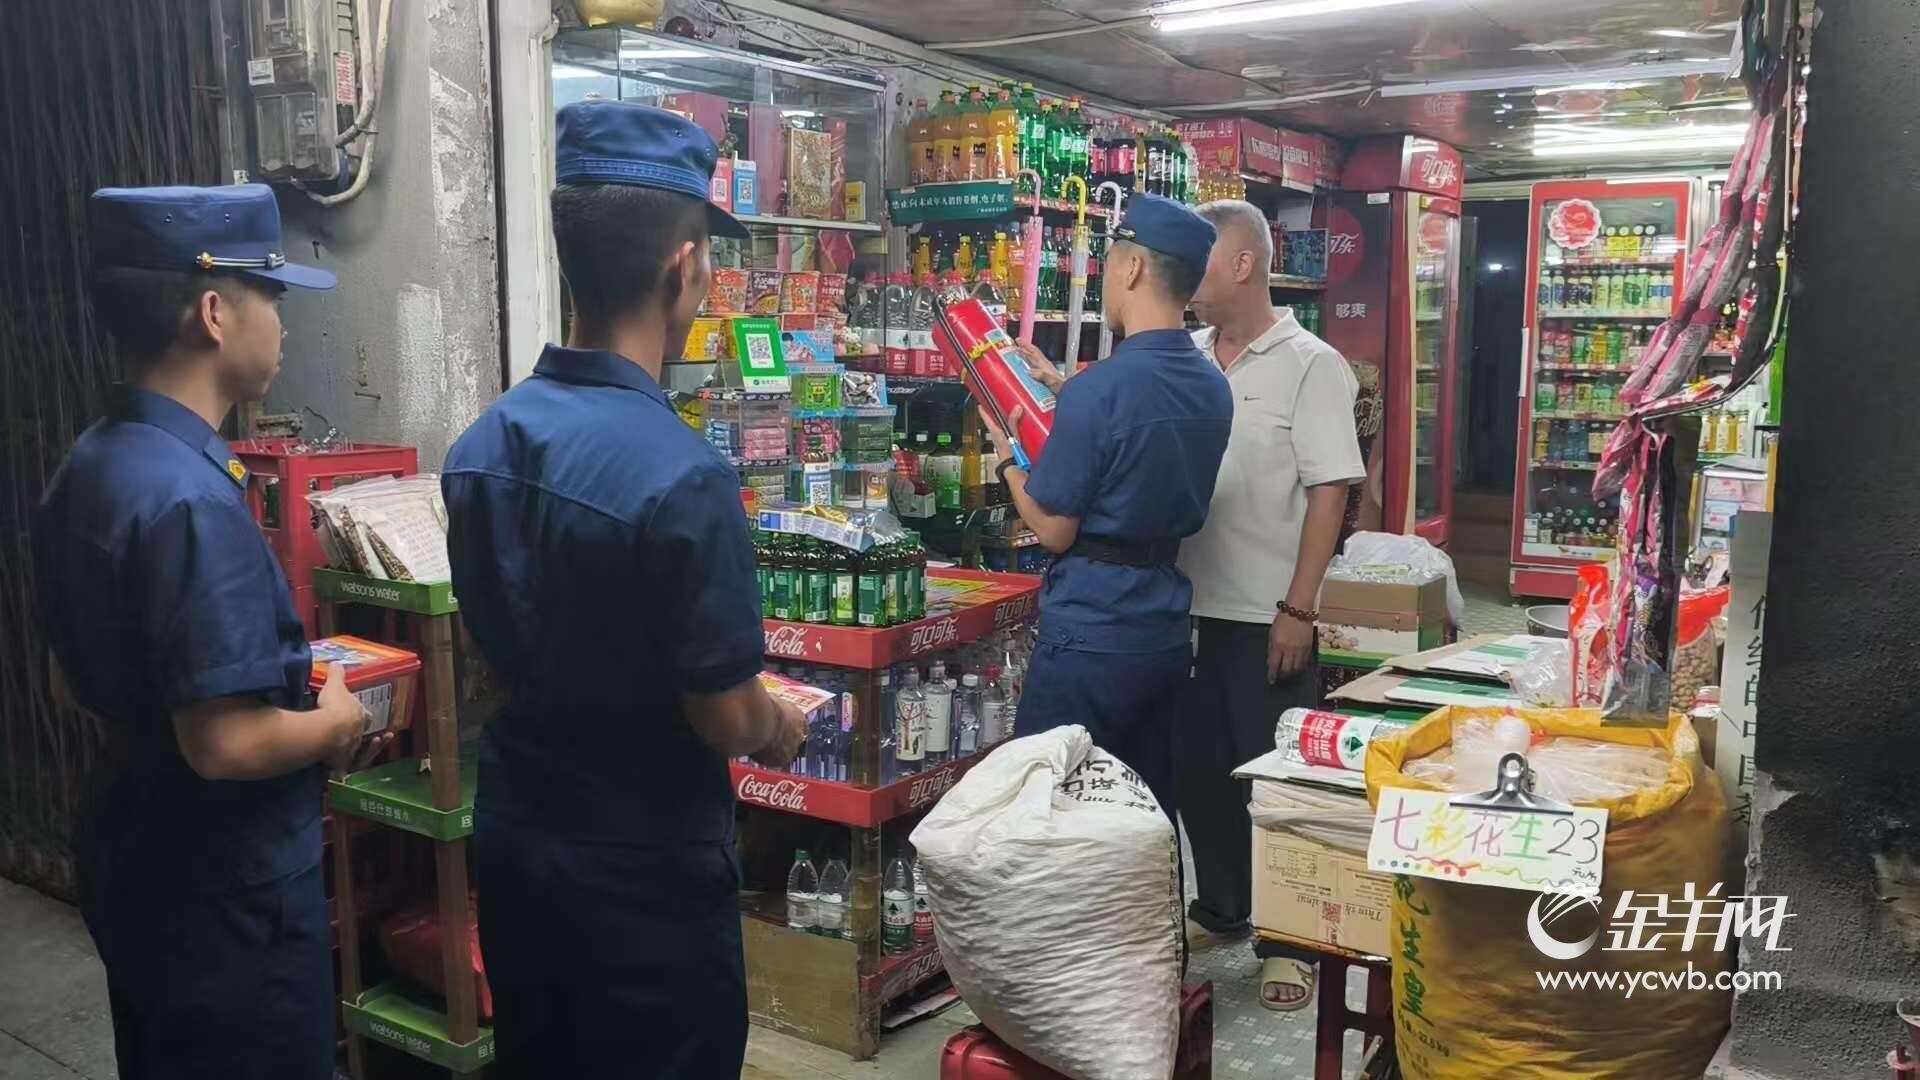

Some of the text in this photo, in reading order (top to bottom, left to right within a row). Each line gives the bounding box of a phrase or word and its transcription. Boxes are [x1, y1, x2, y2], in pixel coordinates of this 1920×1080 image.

[1335, 303, 1366, 319] 够爽
[341, 581, 401, 601] watsons water
[910, 616, 960, 654] 可口可乐
[738, 773, 809, 811] Coca-Cola
[1380, 797, 1600, 865] 七彩花生23
